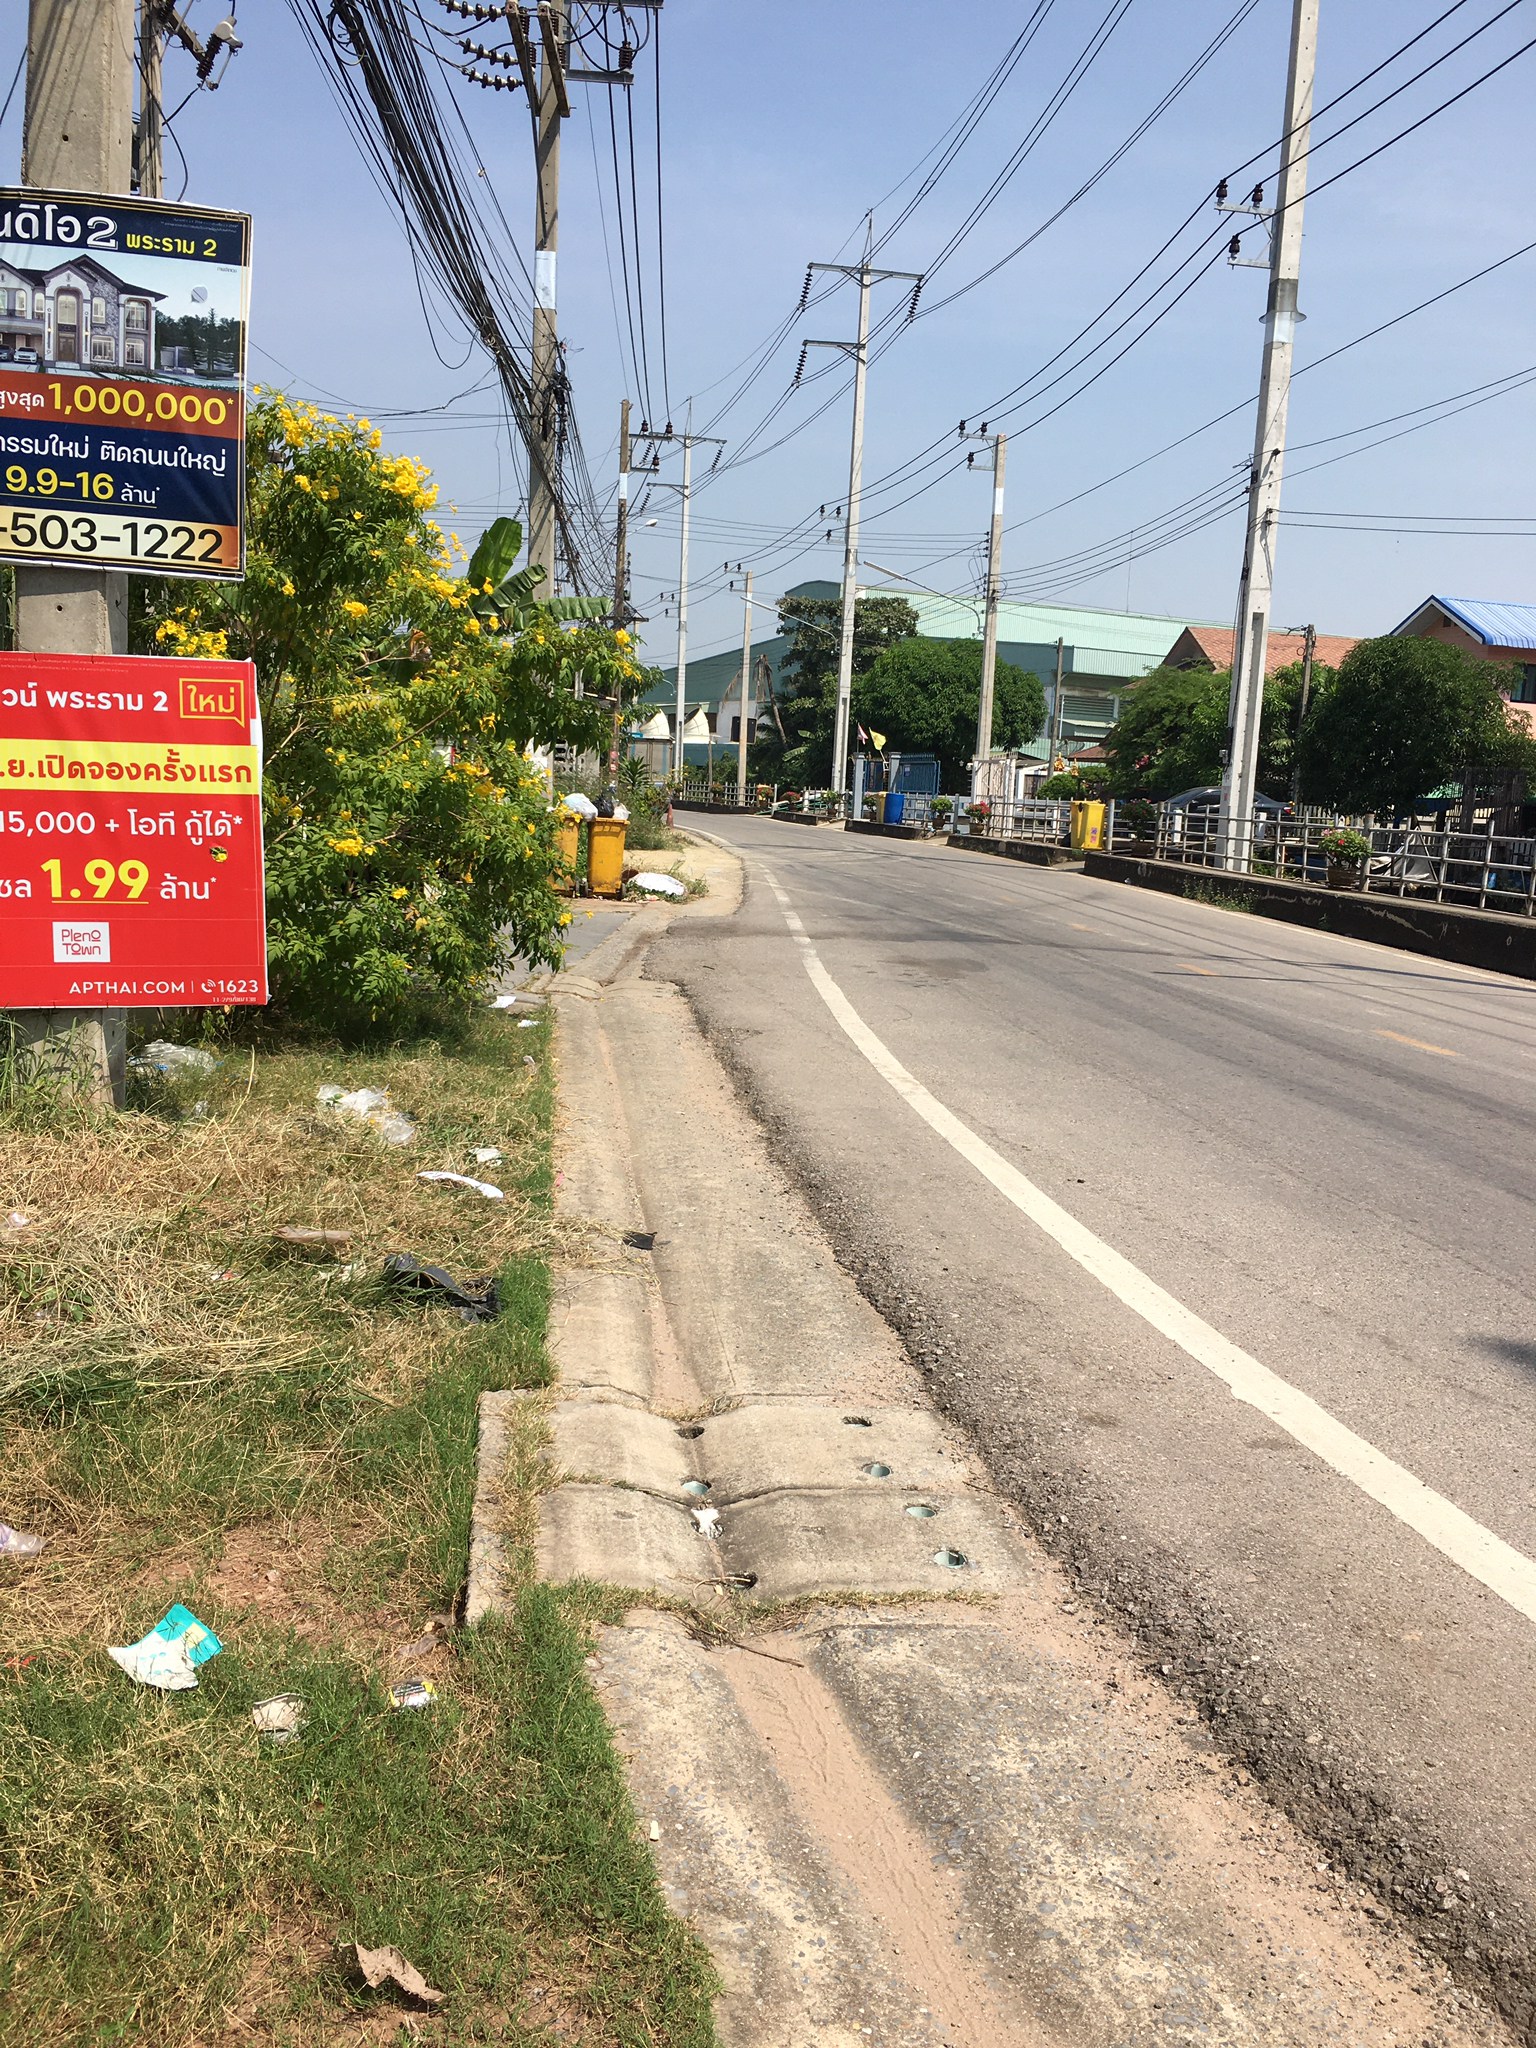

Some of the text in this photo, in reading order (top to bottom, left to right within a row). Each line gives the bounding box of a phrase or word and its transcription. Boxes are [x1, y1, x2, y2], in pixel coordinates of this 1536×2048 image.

[126, 234, 195, 254] พระราม
[203, 239, 217, 257] 2
[100, 441, 226, 477] ติดถนนใหญ่
[5, 465, 114, 500] 9.9-16
[46, 690, 143, 711] พระราม
[152, 690, 169, 712] 2
[187, 685, 235, 713] ใหม่
[105, 818, 120, 833] +
[127, 808, 175, 836] โอที
[40, 858, 150, 899] 1.99
[69, 979, 259, 994] APTHAI.COM 1623
